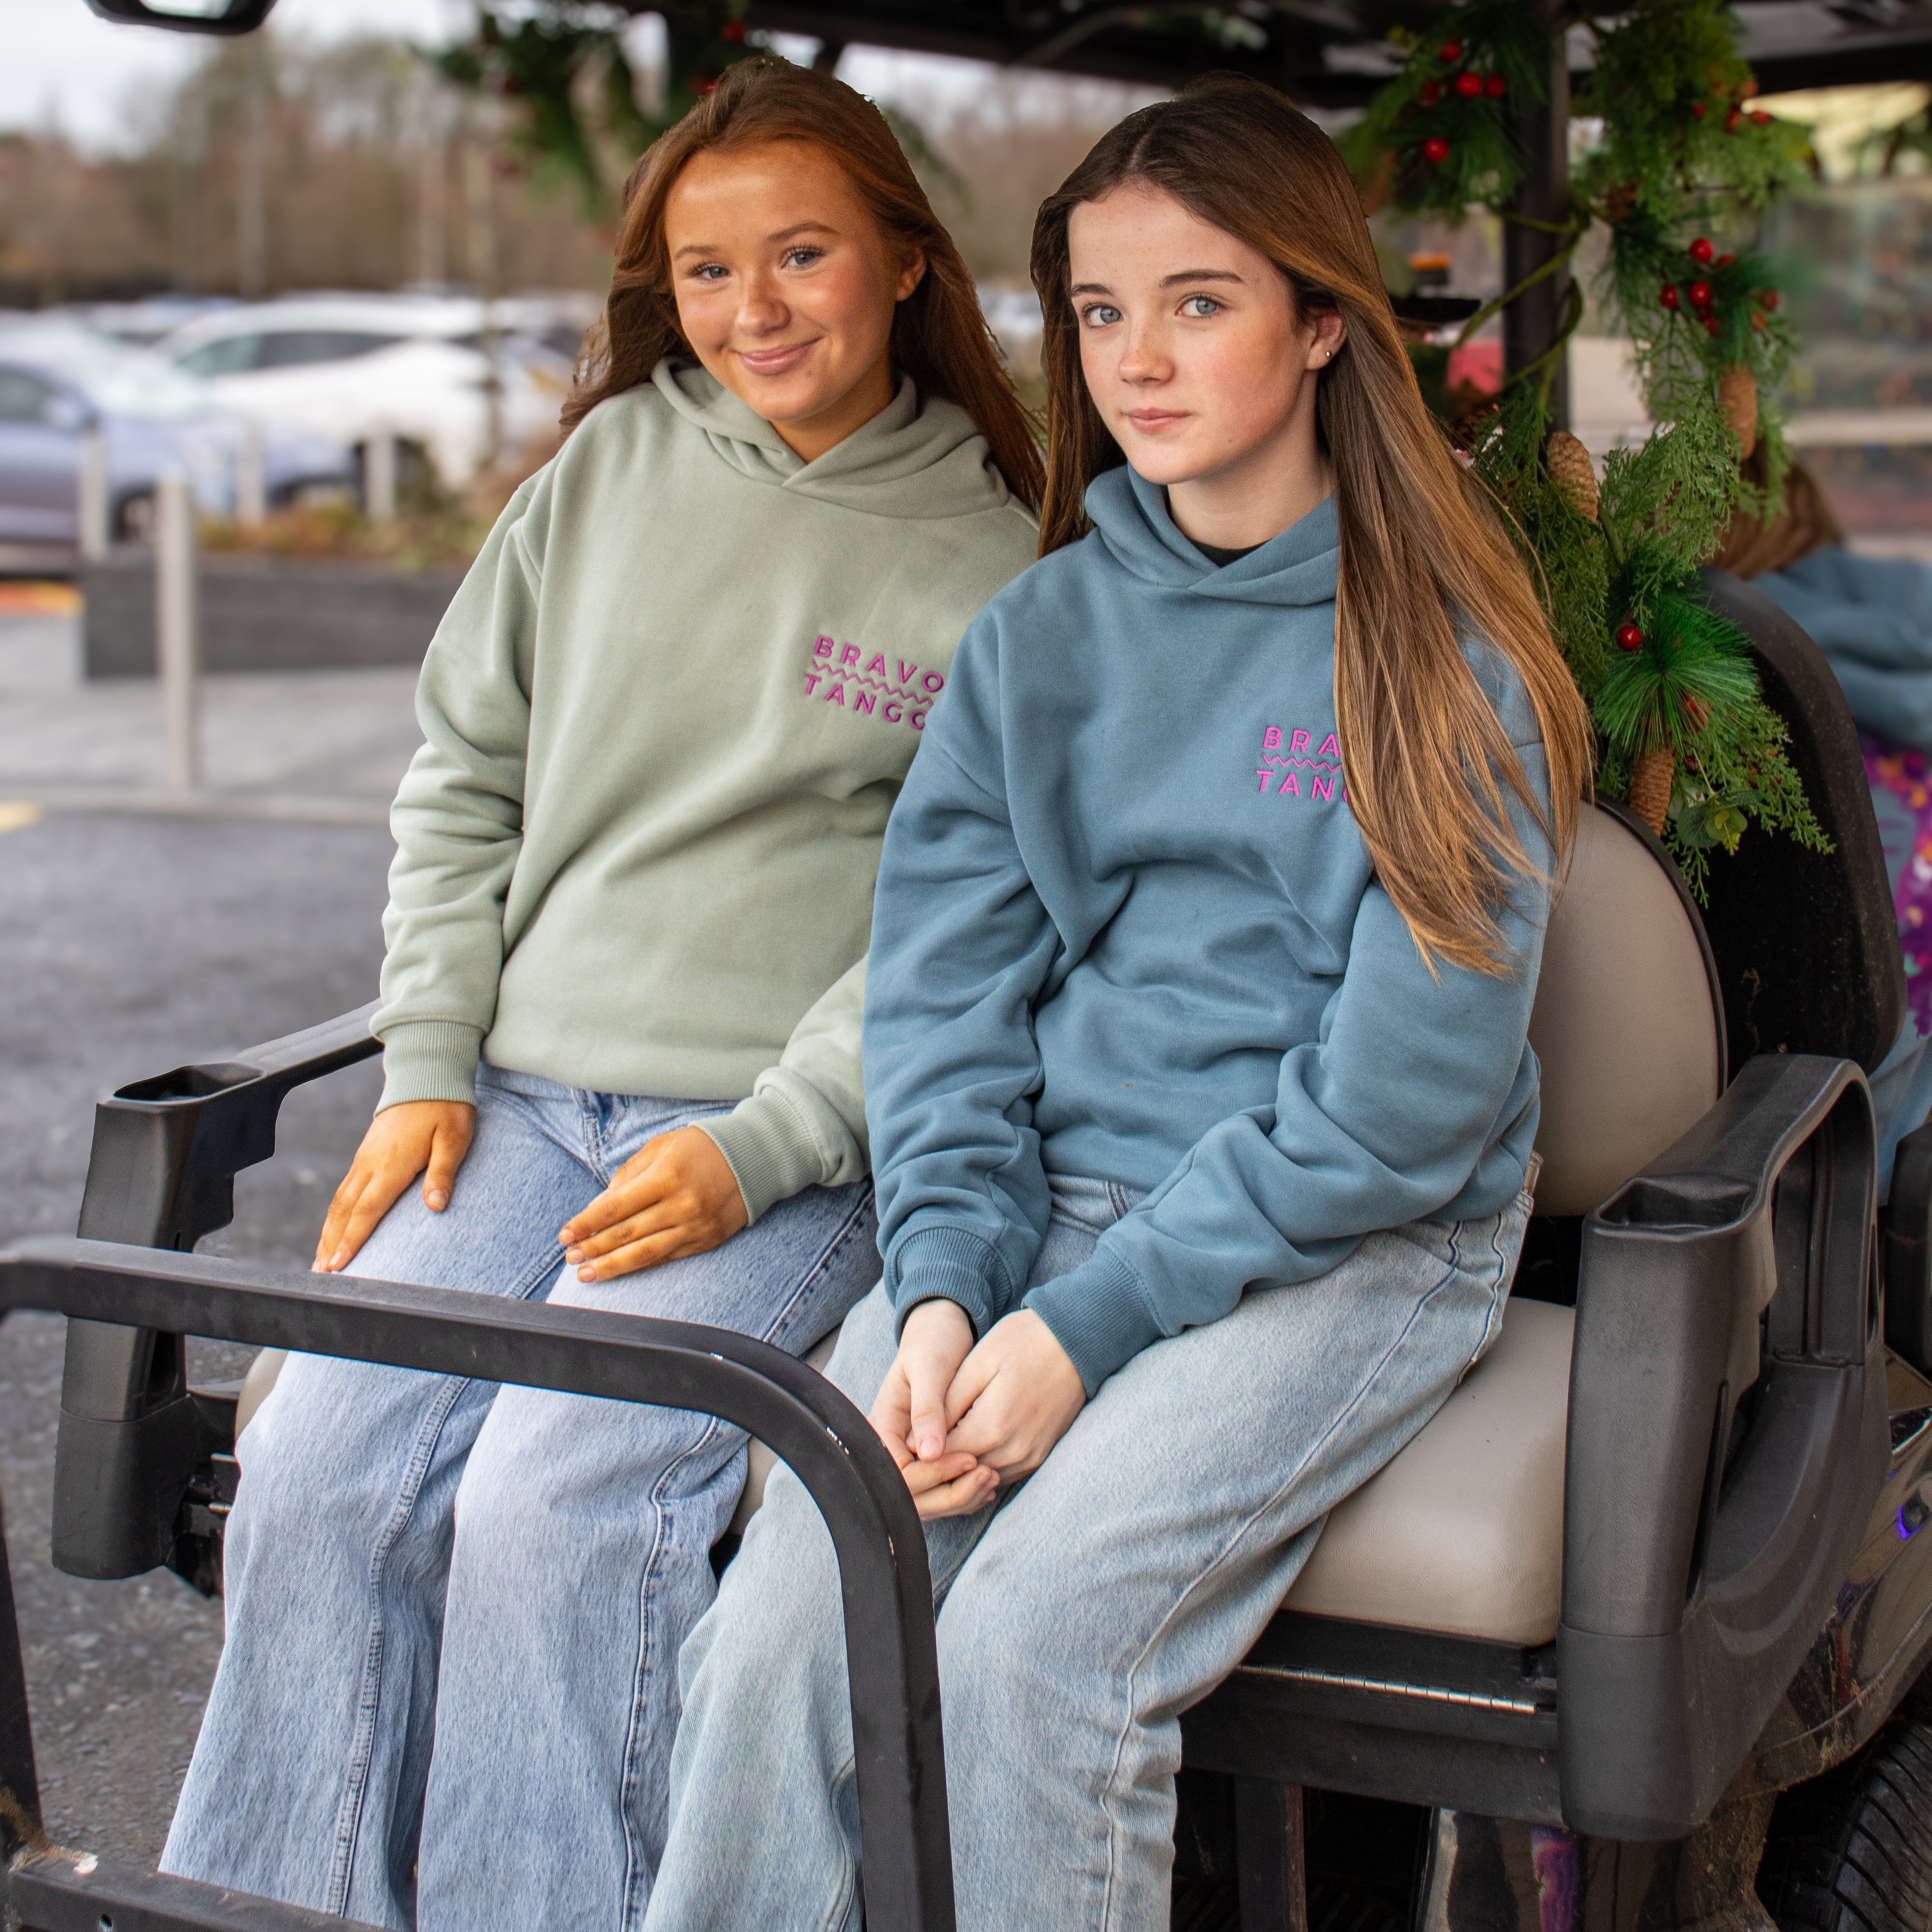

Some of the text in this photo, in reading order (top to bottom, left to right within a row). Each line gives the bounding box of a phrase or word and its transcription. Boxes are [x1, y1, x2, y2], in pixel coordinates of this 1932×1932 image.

[813, 635, 944, 693] BRAVO
[805, 673, 927, 730] TANGO
[1256, 769, 1348, 803] TAN
